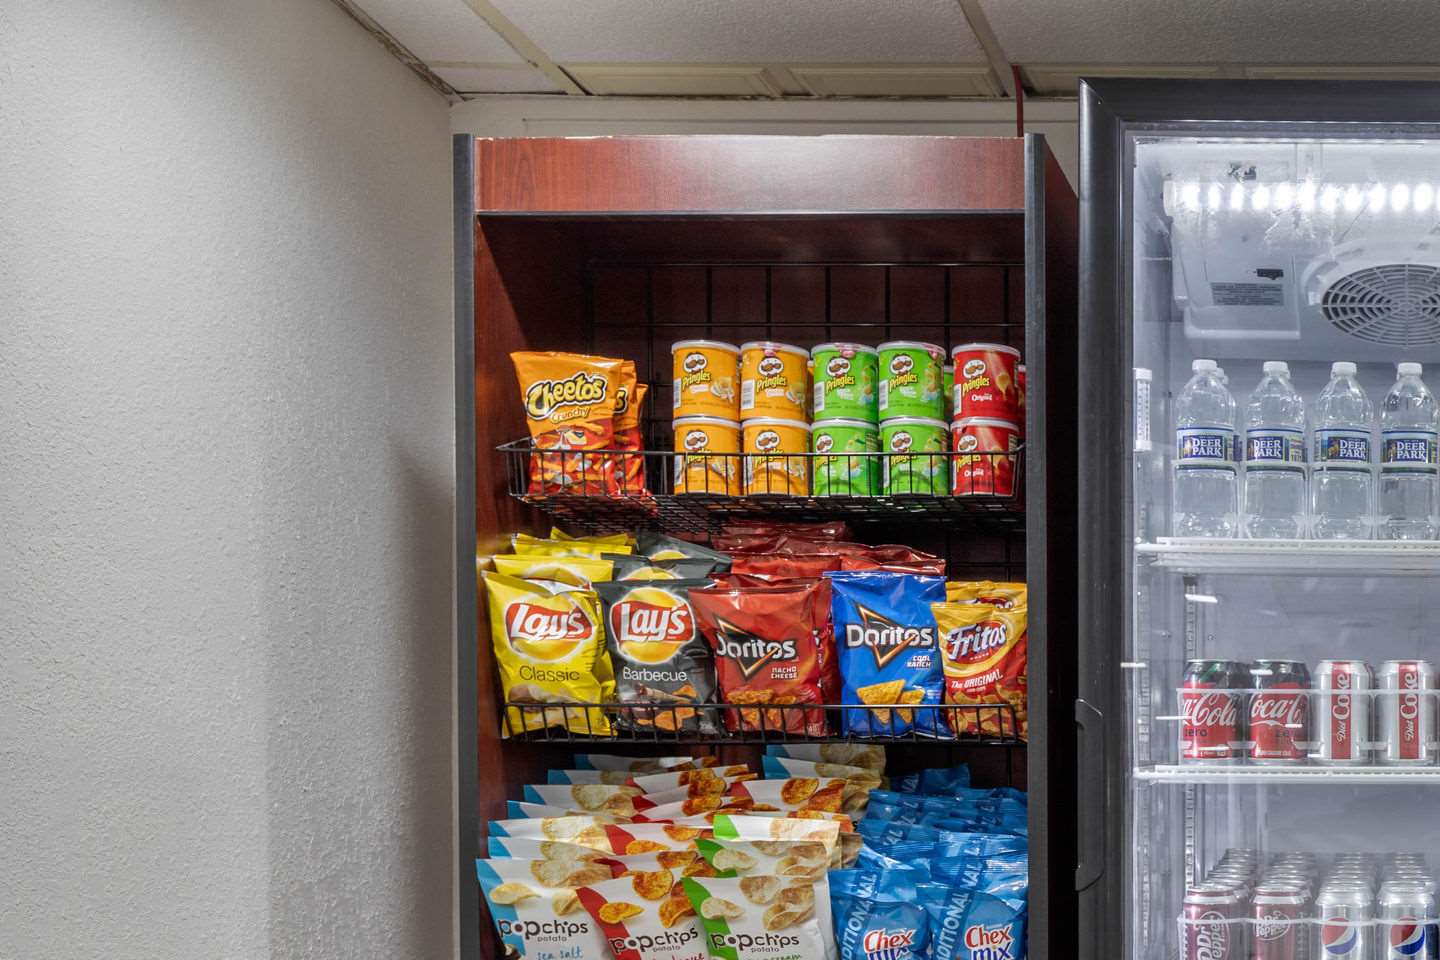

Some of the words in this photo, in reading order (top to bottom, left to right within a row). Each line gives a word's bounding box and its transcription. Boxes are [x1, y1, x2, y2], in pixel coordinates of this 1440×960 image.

[682, 371, 712, 388] Pringles
[756, 375, 788, 392] Pringles
[826, 375, 855, 393] Pringles
[889, 372, 918, 391] Pringles
[962, 377, 990, 396] Pringles
[525, 373, 608, 419] Cheetos
[551, 406, 591, 423] Crunchy
[1192, 437, 1221, 448] DEER
[1192, 447, 1223, 457] PARK
[1253, 438, 1282, 449] DEER
[1340, 439, 1366, 450] DEER
[1396, 441, 1425, 452] DEER
[1340, 449, 1367, 459] PARK
[1396, 451, 1426, 461] PARK
[510, 604, 586, 643] Lay's
[620, 602, 688, 642] Lay's
[846, 624, 934, 648] Doritos
[949, 623, 1008, 660] Fritos
[519, 666, 581, 682] Classic
[623, 666, 688, 682] Barbecue
[964, 668, 1004, 689] ORIGINAL
[1332, 672, 1351, 720] Coke
[1400, 672, 1419, 720] Coke
[498, 919, 589, 941] popchips
[965, 922, 1013, 951] Chex
[609, 926, 699, 954] popchips
[711, 932, 800, 951] popchips
[864, 927, 917, 953] Chex
[537, 950, 555, 960] sea
[560, 946, 584, 960] salt
